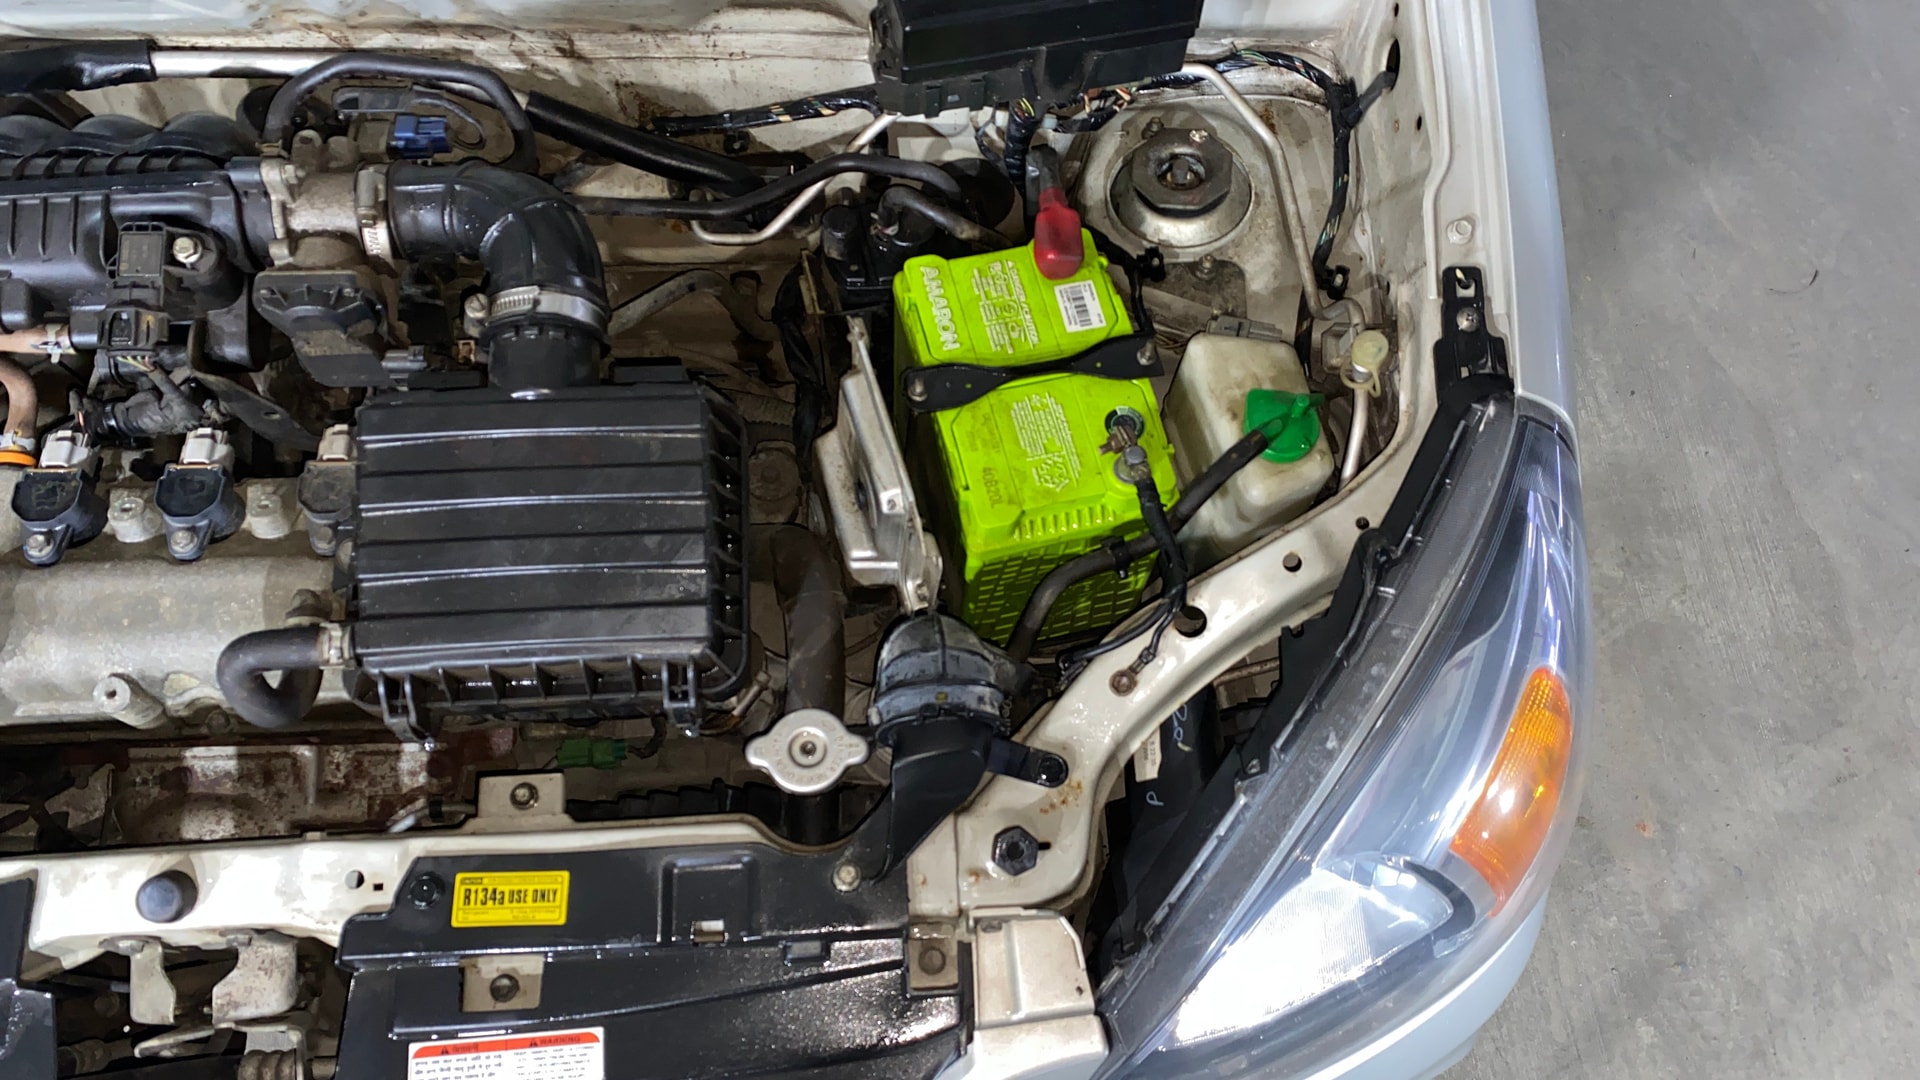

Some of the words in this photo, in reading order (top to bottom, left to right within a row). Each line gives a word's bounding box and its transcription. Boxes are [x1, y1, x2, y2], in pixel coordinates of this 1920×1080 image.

[920, 266, 960, 351] AMARON
[463, 887, 505, 906] R134a
[508, 889, 528, 904] USE
[532, 888, 558, 904] ONLY
